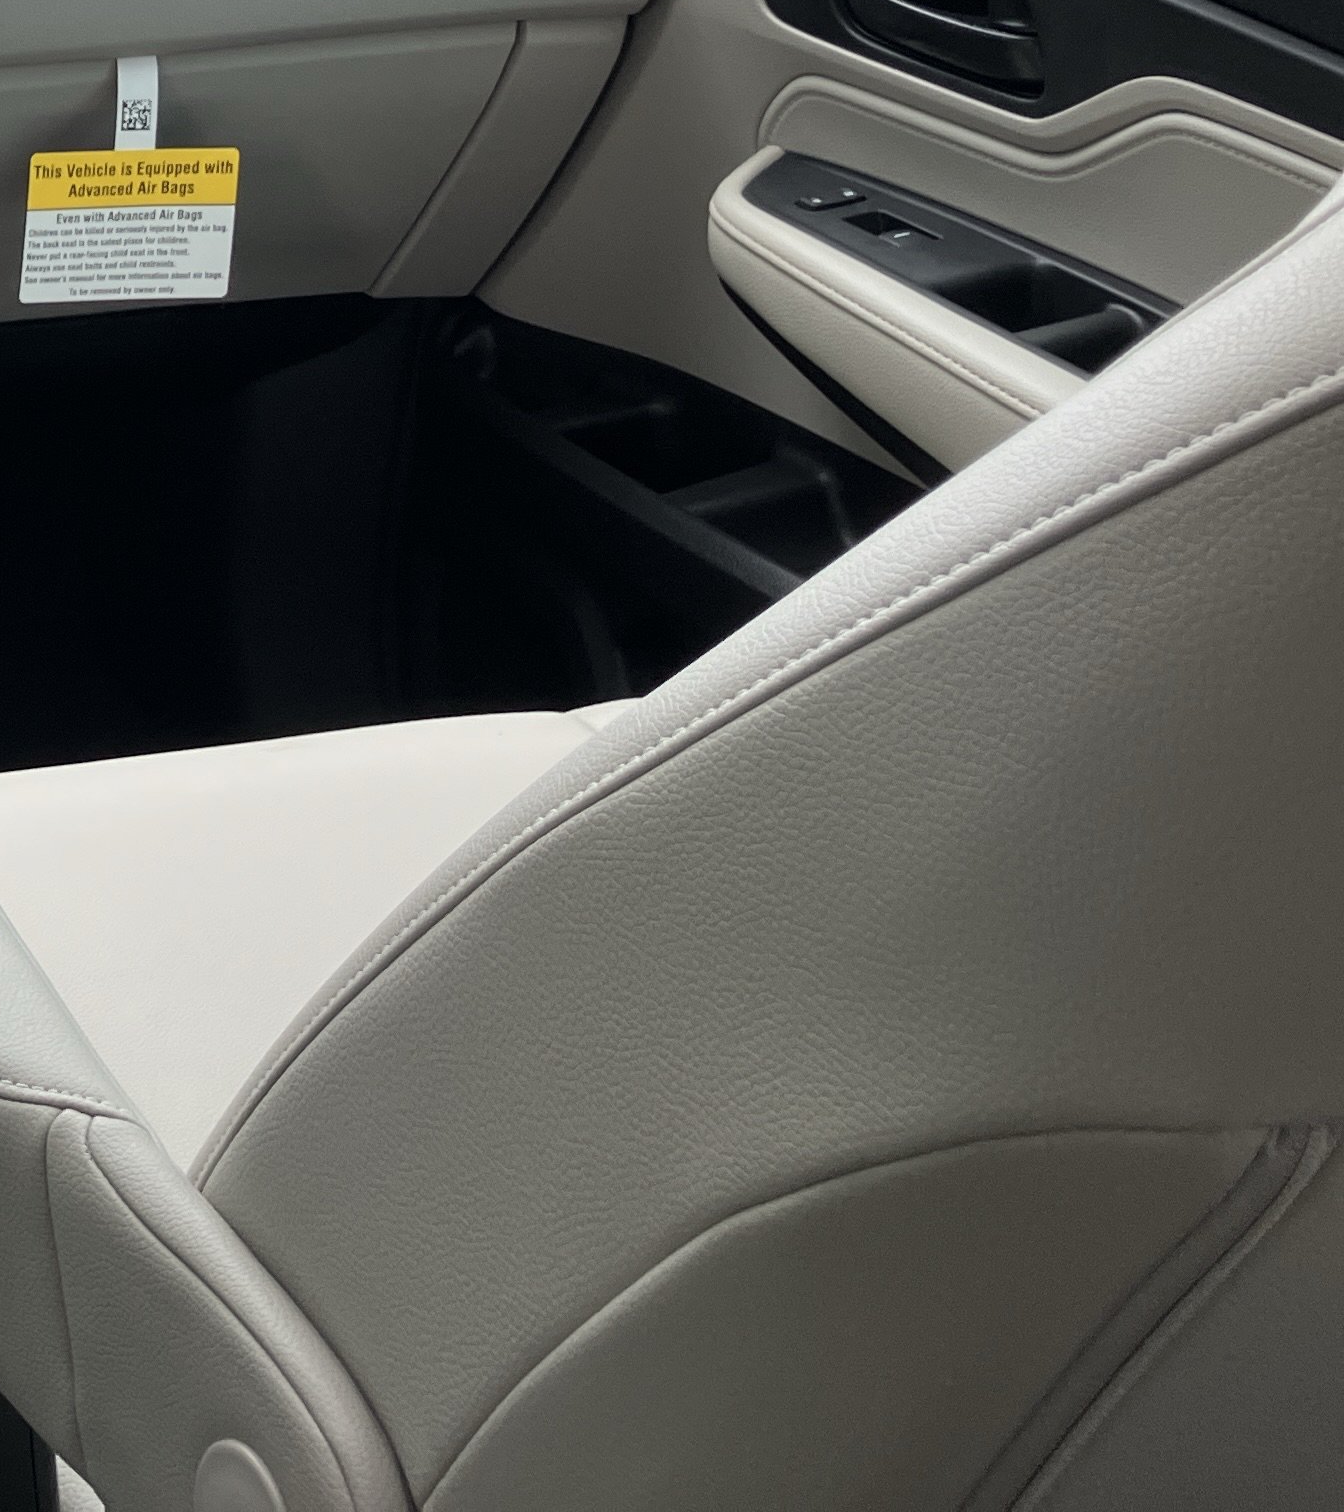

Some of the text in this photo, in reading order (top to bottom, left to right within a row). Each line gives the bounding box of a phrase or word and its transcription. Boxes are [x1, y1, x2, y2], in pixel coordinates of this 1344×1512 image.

[32, 159, 234, 180] This Vehicle is Equipped with
[67, 180, 195, 198] Advanced Air Bags
[55, 209, 203, 224] Even with Advanced Air Bags
